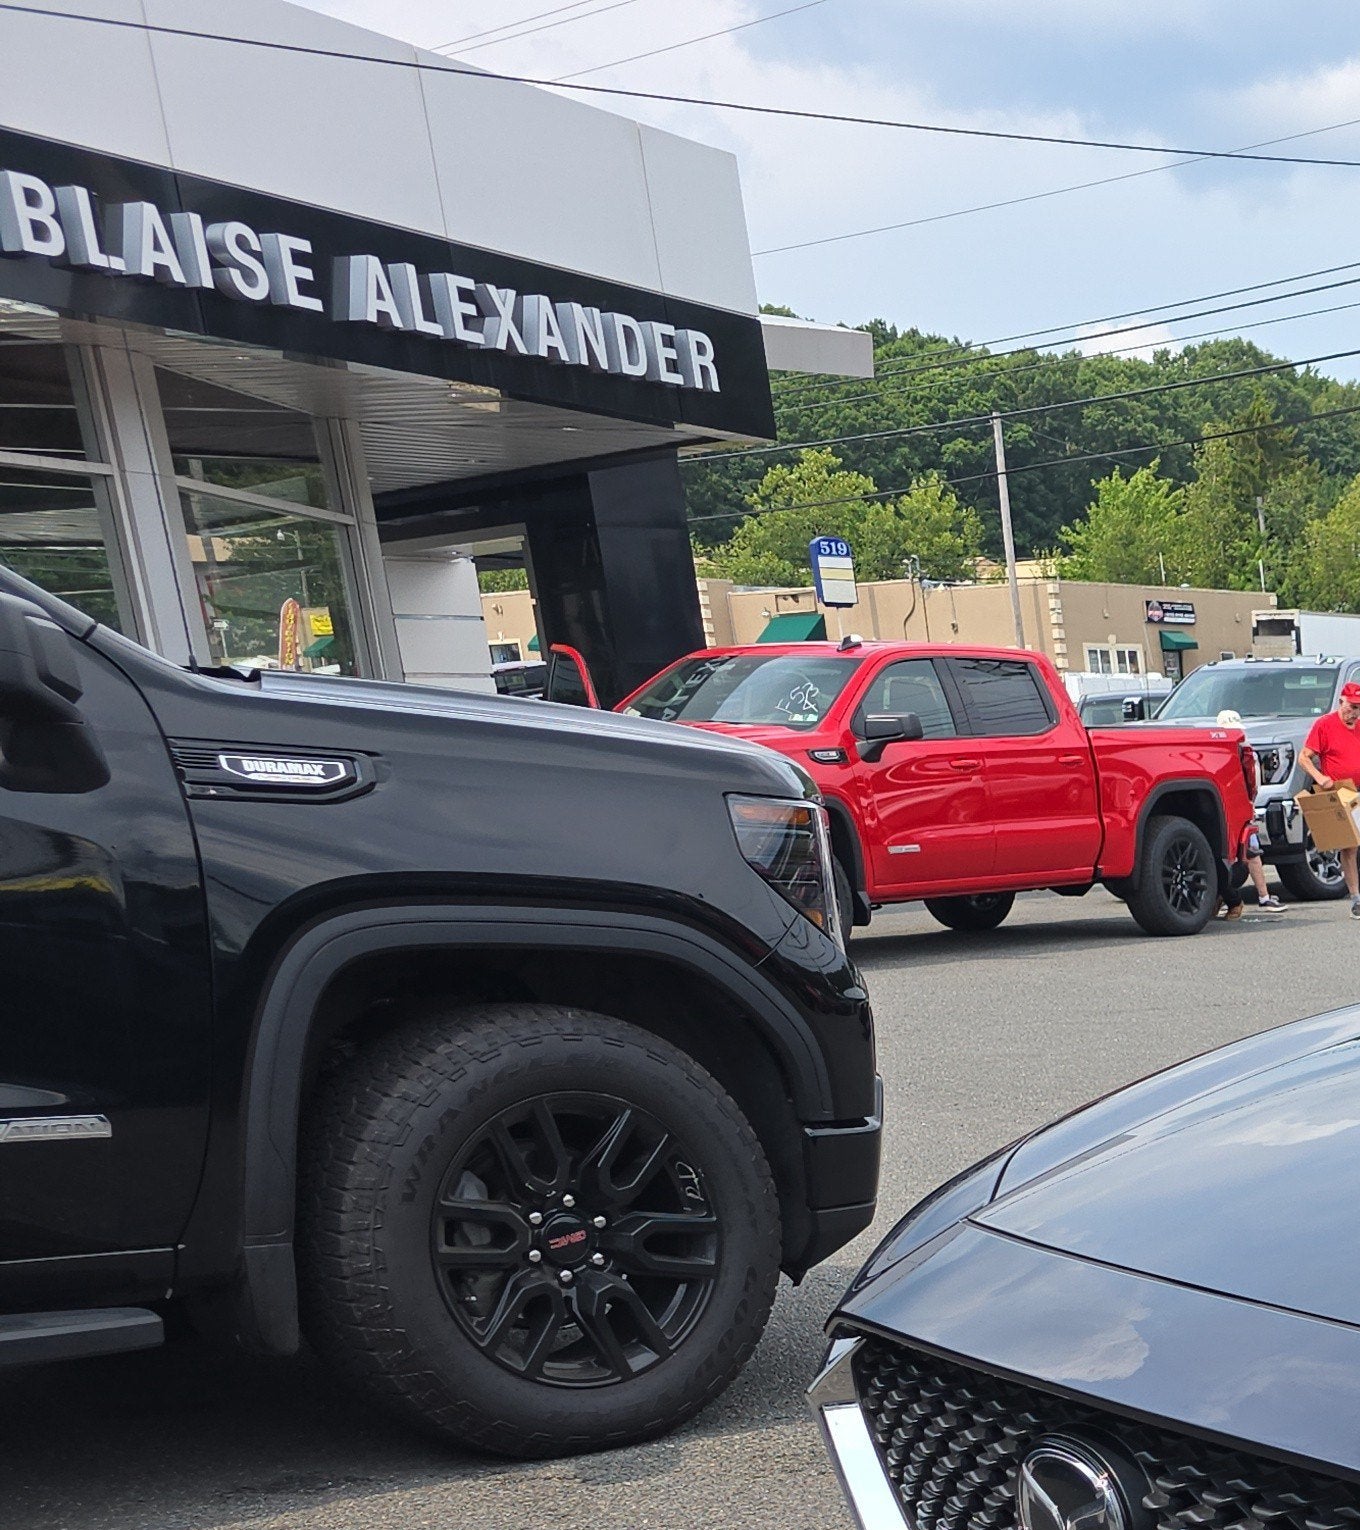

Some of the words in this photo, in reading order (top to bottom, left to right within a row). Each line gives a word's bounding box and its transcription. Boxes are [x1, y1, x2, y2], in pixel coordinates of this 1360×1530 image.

[0, 168, 324, 313] BLAISE
[348, 254, 720, 393] ALEXANDER
[820, 541, 848, 556] 519
[241, 759, 326, 776] DURAMAX
